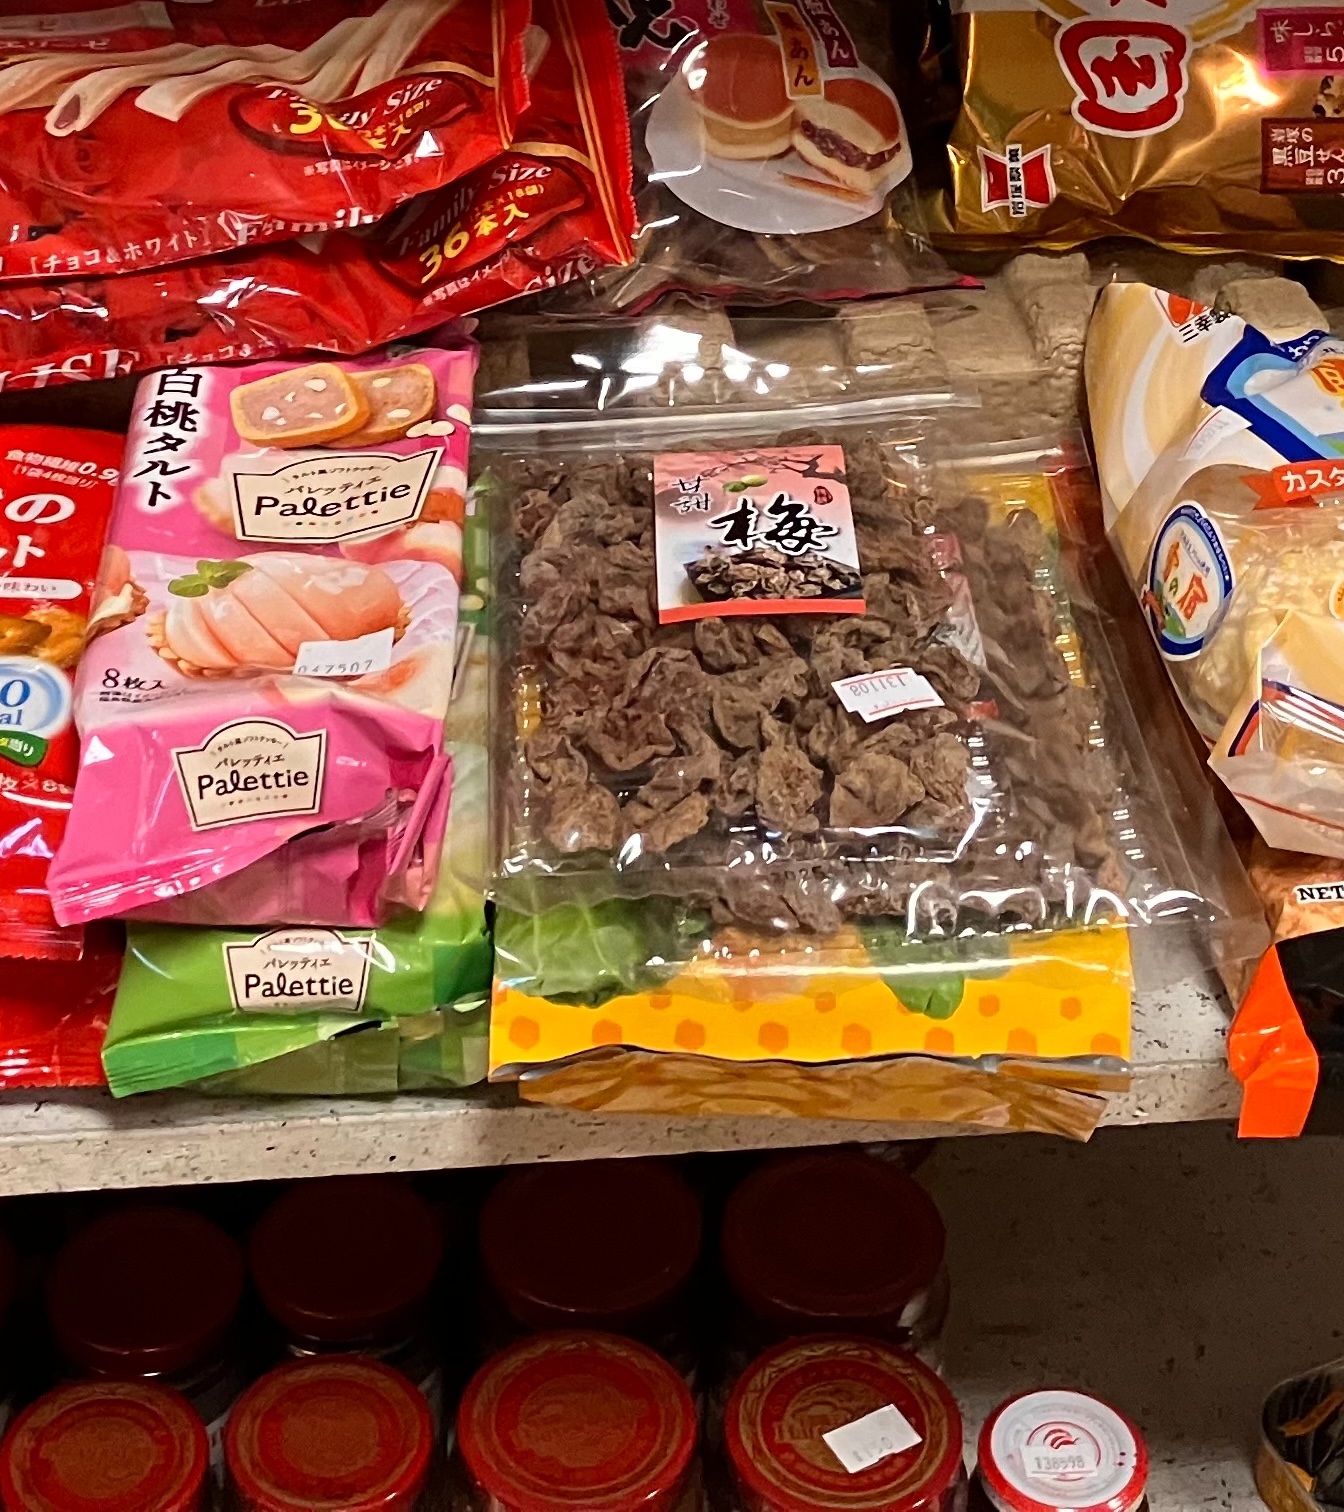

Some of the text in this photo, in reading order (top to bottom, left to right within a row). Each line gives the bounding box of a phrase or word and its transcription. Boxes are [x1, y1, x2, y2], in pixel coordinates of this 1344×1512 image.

[382, 78, 443, 115] Size
[487, 162, 553, 191] Size
[417, 202, 530, 285] 36本入
[132, 367, 204, 509] 白桃タルト
[253, 482, 412, 518] Palettie
[709, 492, 838, 554] 梅
[101, 667, 167, 691] 8枚入
[196, 768, 310, 801] Palettie
[244, 972, 355, 1000] Palettie
